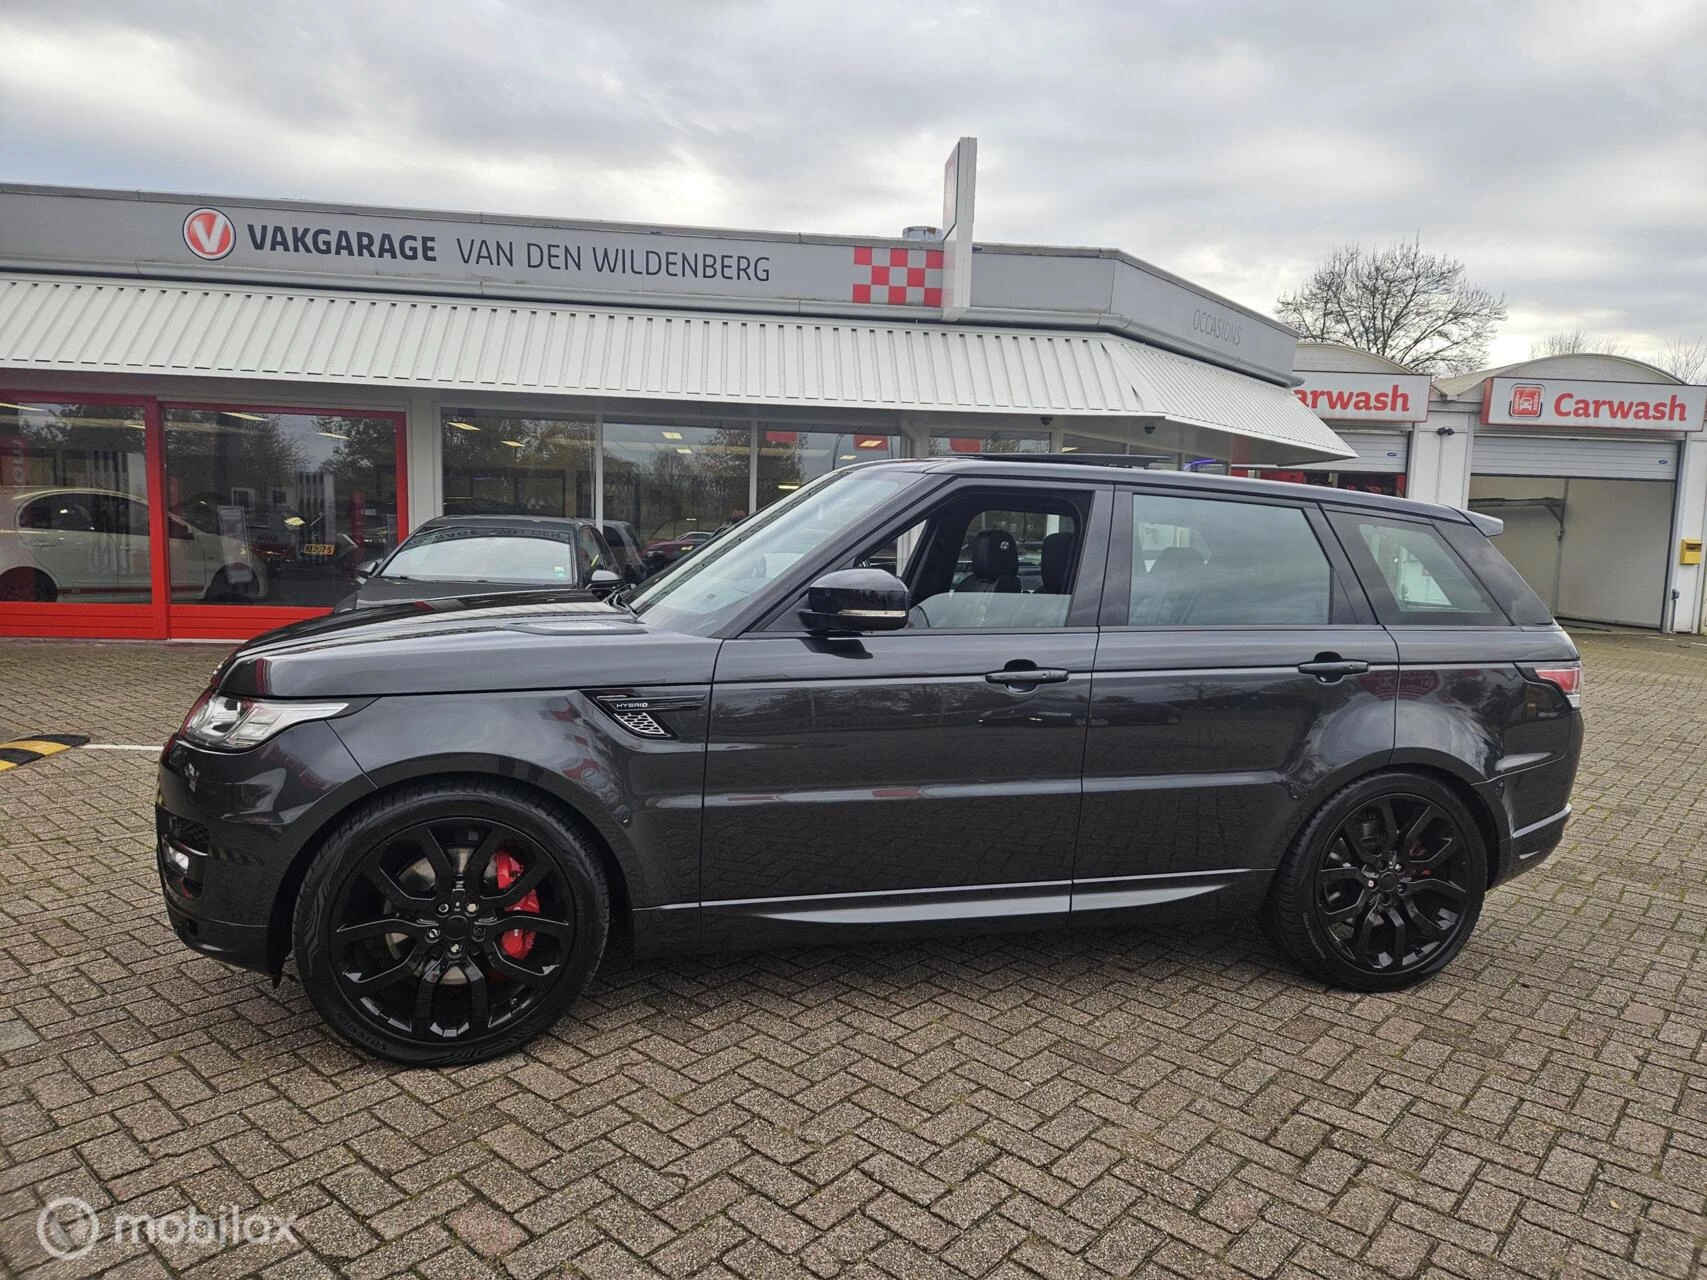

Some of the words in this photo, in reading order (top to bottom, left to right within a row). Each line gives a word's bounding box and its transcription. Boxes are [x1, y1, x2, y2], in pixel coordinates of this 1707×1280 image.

[247, 224, 437, 262] VAKGARAGE
[456, 237, 514, 267] VAN
[526, 242, 581, 271] DEN
[592, 246, 770, 282] WILDENBERG
[1192, 309, 1242, 346] OCCASIONS
[1293, 384, 1410, 412] arwash
[1553, 393, 1688, 422] Carwash
